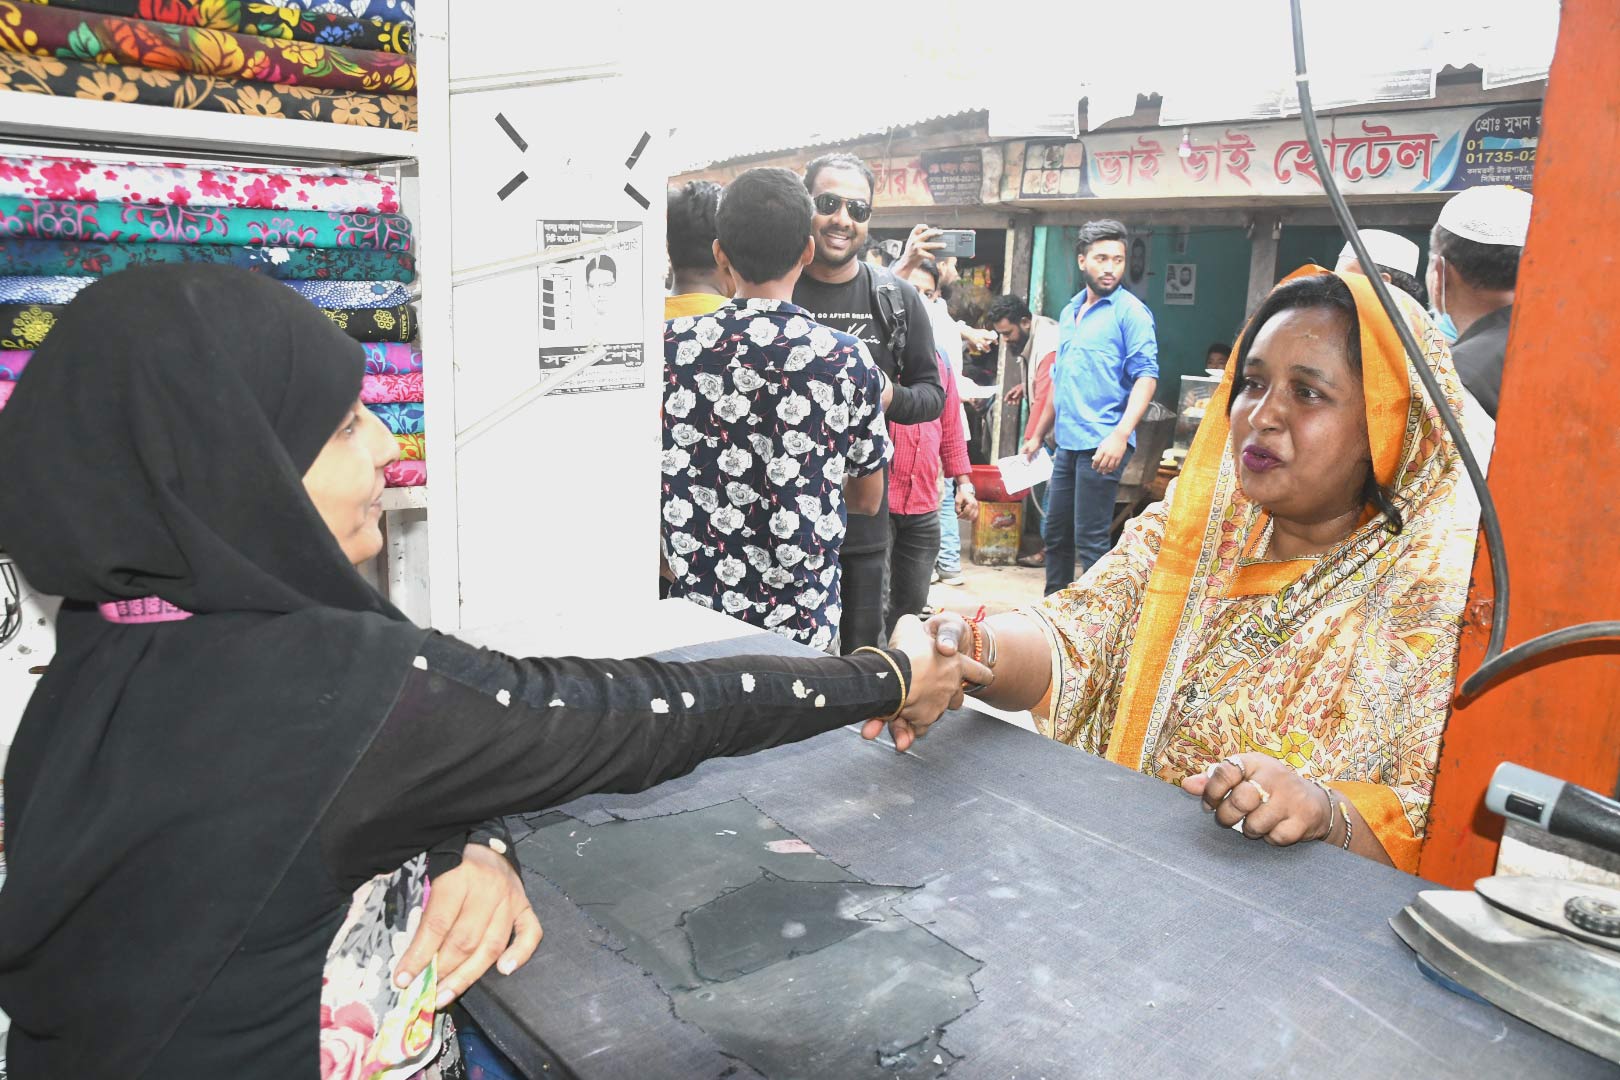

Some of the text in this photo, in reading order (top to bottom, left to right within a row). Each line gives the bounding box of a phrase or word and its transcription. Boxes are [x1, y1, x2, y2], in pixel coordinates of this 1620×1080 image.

[1504, 116, 1532, 135] সুমন
[1094, 120, 1441, 188] ভাই ভাই হোটেল
